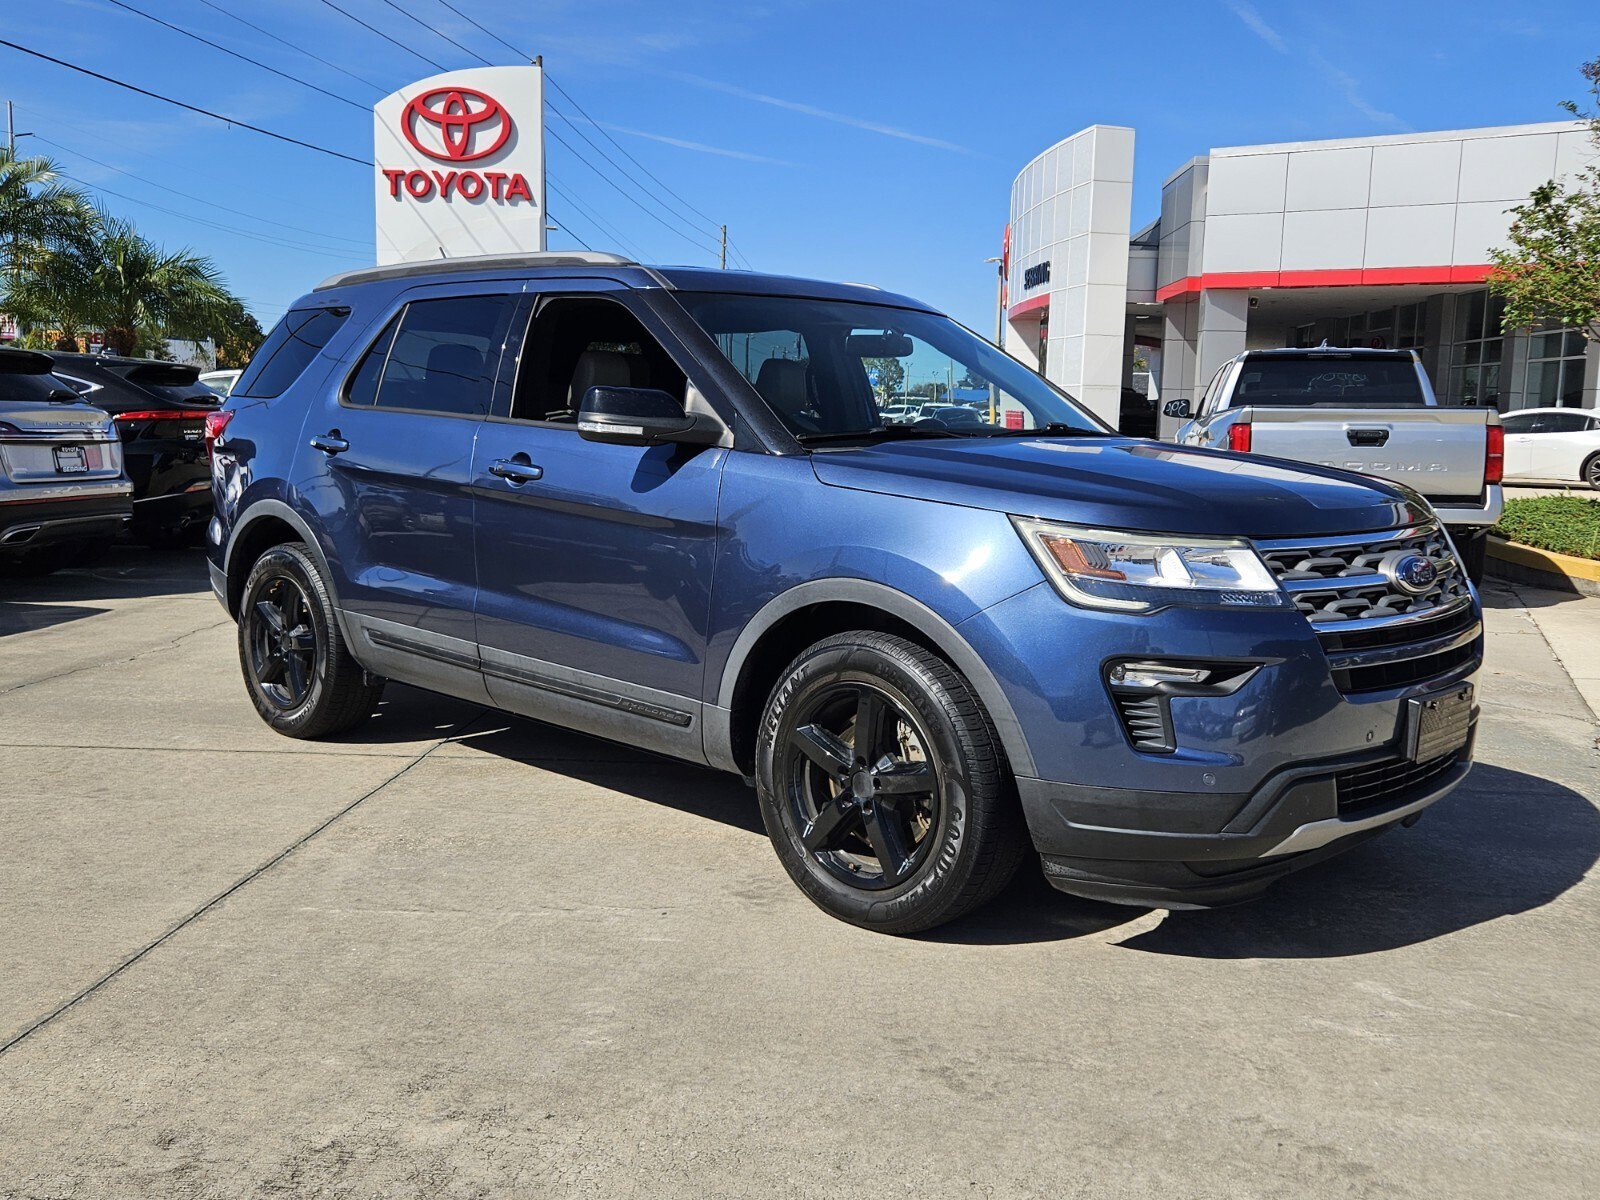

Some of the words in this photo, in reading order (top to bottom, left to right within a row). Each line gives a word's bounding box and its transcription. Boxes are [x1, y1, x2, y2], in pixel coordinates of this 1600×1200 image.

[382, 169, 531, 202] TOYOTA
[621, 700, 683, 721] EXPLORER
[762, 663, 811, 752] RELIANT
[883, 805, 963, 921] GOODYEAR
